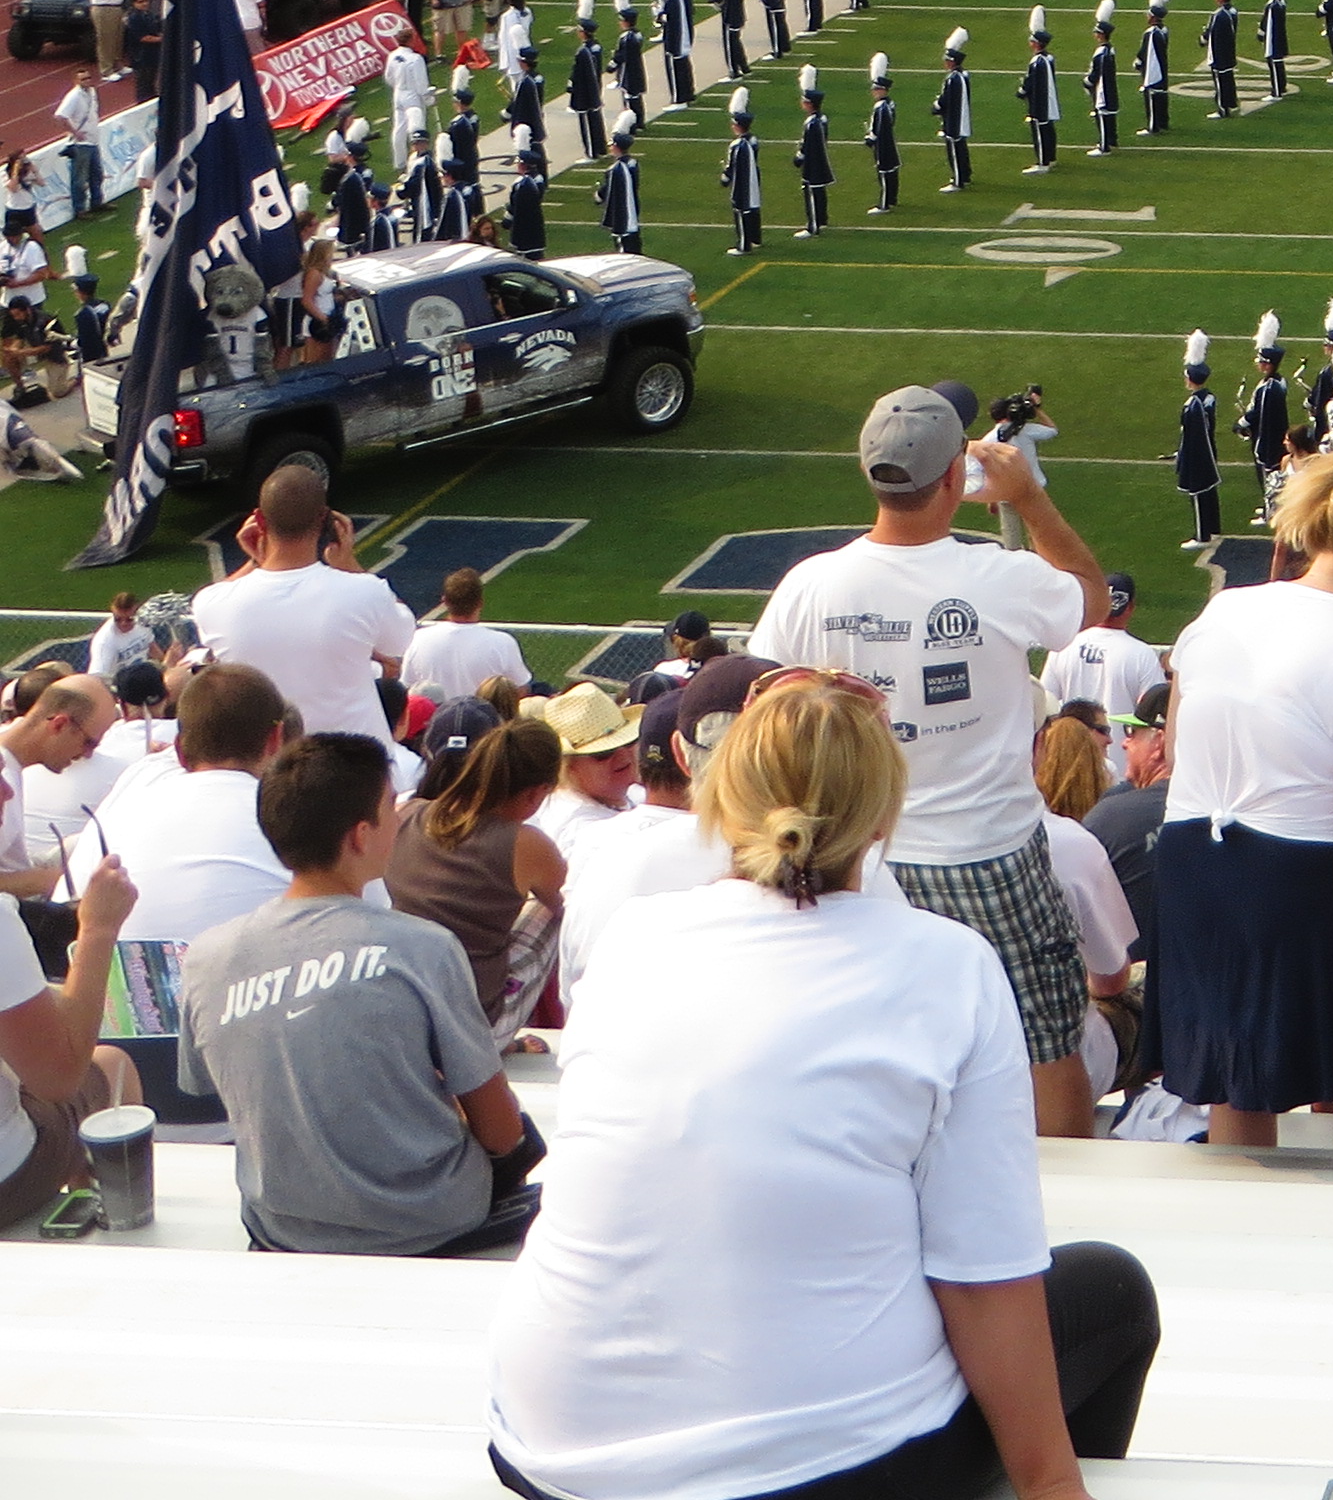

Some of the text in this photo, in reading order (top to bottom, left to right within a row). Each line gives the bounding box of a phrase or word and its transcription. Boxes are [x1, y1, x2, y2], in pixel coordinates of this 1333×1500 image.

[268, 20, 366, 74] NORTHERN
[279, 39, 377, 92] NEVADA
[291, 74, 344, 108] TOYOTA
[965, 202, 1157, 263] 10
[515, 328, 577, 359] NEVADA
[430, 349, 474, 373] BORN
[431, 367, 477, 401] ONE
[927, 673, 966, 686] WELLS
[929, 681, 967, 694] FARGO
[921, 714, 983, 736] in the box
[219, 945, 388, 1025] JUST DO IT.
